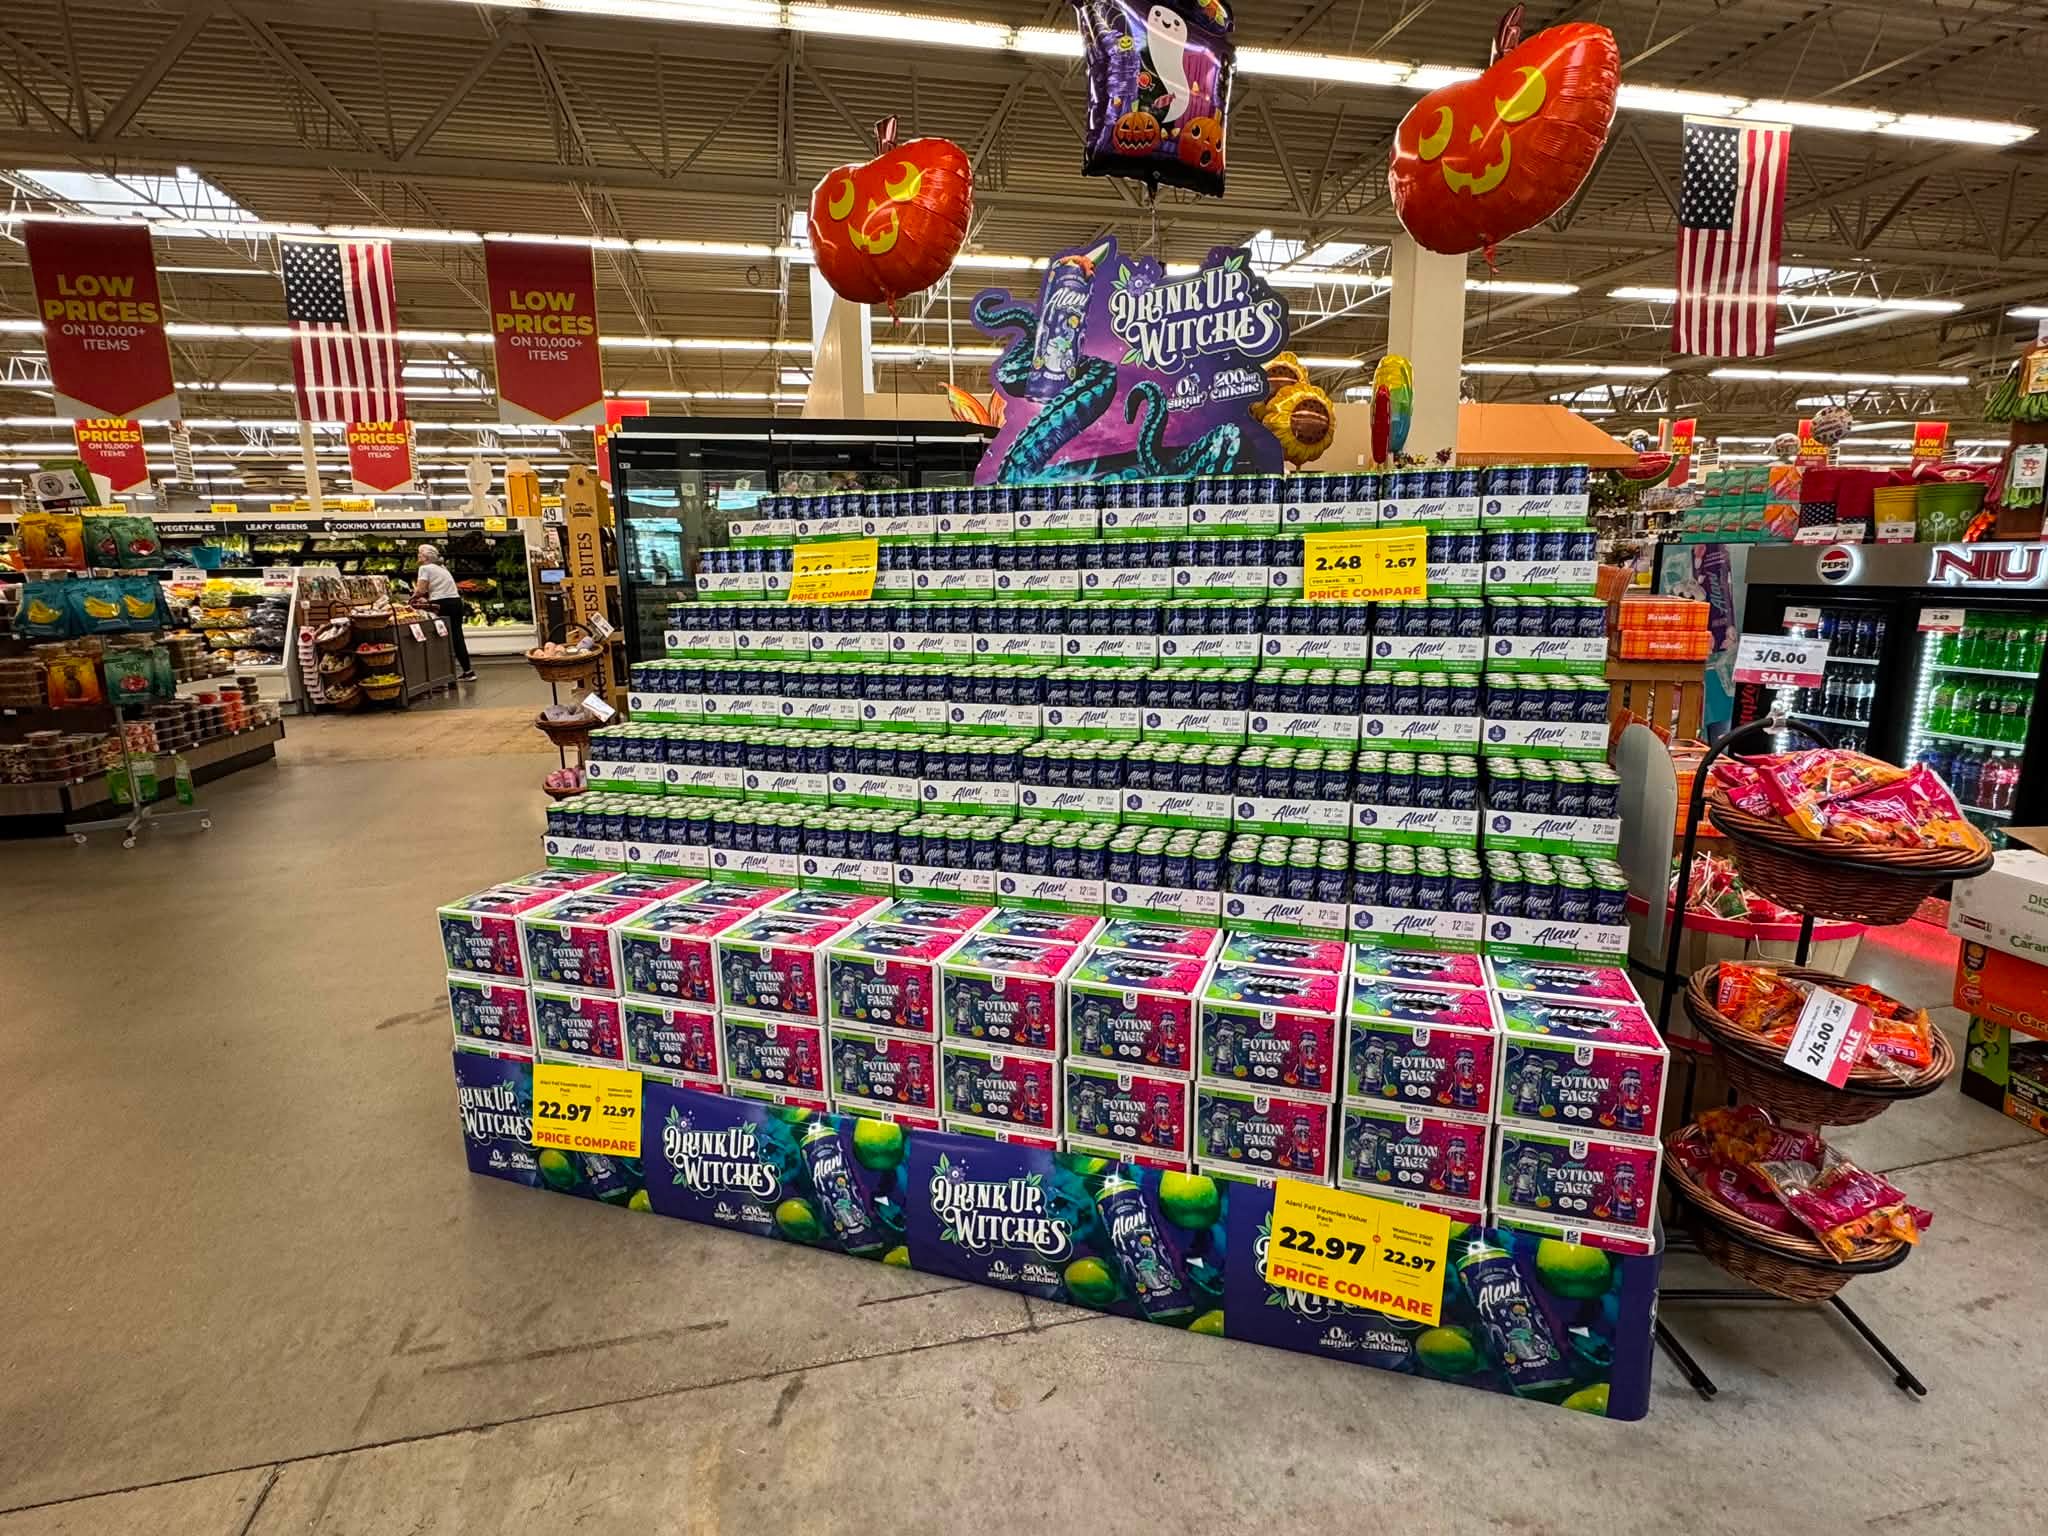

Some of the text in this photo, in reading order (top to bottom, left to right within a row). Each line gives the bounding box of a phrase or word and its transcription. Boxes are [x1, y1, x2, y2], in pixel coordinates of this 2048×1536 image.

[57, 274, 134, 297] LOW
[509, 290, 575, 311] LOW
[1045, 287, 1089, 321] Alani
[1112, 280, 1202, 332] DRINK
[43, 300, 159, 323] PRICES
[62, 324, 145, 338] ON 10,000+
[496, 314, 593, 335] PRICES
[511, 336, 582, 348] ON 10,000+
[1125, 301, 1274, 366] WITCHES
[83, 339, 130, 351] ITEMS
[528, 350, 568, 360] ITEMS
[1168, 383, 1260, 410] sugar caffeine
[87, 418, 127, 428] LOW
[357, 421, 393, 431] LOW
[606, 423, 622, 433] LO
[79, 430, 140, 442] PRICES
[350, 433, 406, 444] PRICES
[1920, 439, 1940, 447] LOW
[1914, 447, 1944, 456] PRICES
[1517, 499, 1553, 516] Alani
[160, 524, 216, 532] VEGETABLES
[275, 523, 308, 531] GREENS
[335, 521, 421, 530] OOKING VEGETABLES
[448, 521, 467, 529] EAFY
[577, 532, 595, 577] BITES
[1316, 556, 1416, 571] 2.48 2.67
[1931, 546, 2043, 583] NIU
[822, 590, 869, 599] COMPARE
[1309, 586, 1421, 599] PRICE COMPARE
[1530, 640, 1570, 659] Alani
[1754, 649, 1807, 664] 3/8.00
[1760, 672, 1795, 683] SALE
[1177, 714, 1210, 732] Alani
[1401, 720, 1440, 740] Alani
[1052, 792, 1084, 809] Alani
[1532, 820, 1576, 840] Alani
[832, 861, 861, 878] Alani
[929, 871, 961, 888] Alani
[1033, 881, 1066, 899] Alani
[1144, 891, 1183, 910] Alani
[1264, 904, 1304, 923] Alani
[1393, 915, 1437, 936] Alani
[1533, 926, 1582, 948] Alani
[651, 960, 683, 970] POTION
[750, 971, 785, 982] POTION
[861, 984, 899, 995] POTION
[867, 995, 894, 1006] PACK
[978, 1000, 1019, 1013] POTION
[984, 1012, 1012, 1024] PACK
[1107, 1018, 1151, 1031] POTION
[1114, 1030, 1144, 1043] PACK
[1241, 1038, 1291, 1052] POTION
[1807, 1023, 1834, 1066] 2/5.00
[1840, 1029, 1862, 1063] SALE
[1249, 1050, 1282, 1064] PACK
[1393, 1056, 1446, 1071] POTION
[1400, 1069, 1437, 1083] PACK
[1552, 1076, 1610, 1091] POTION
[457, 1087, 495, 1110] RINK
[1559, 1089, 1599, 1103] PACK
[538, 1101, 635, 1122] 22.97 22.97
[459, 1105, 534, 1144] WITCHES
[537, 1131, 636, 1152] PRICE COMPARE
[665, 1126, 728, 1158] DRINK
[814, 1152, 843, 1180] Alani
[674, 1154, 776, 1196] WITCHES
[1547, 1168, 1604, 1183] POTION
[932, 1176, 1008, 1213] DRINK
[1554, 1181, 1594, 1195] PACK
[943, 1207, 1065, 1254] WITCHES
[1112, 1211, 1146, 1240] Alani
[1279, 1226, 1436, 1273] 22.97 22.97
[1273, 1264, 1329, 1289] PRICE
[1334, 1280, 1433, 1317] COMPARE
[1479, 1278, 1520, 1310] Alani
[1320, 1337, 1408, 1353] sugar caffeine
